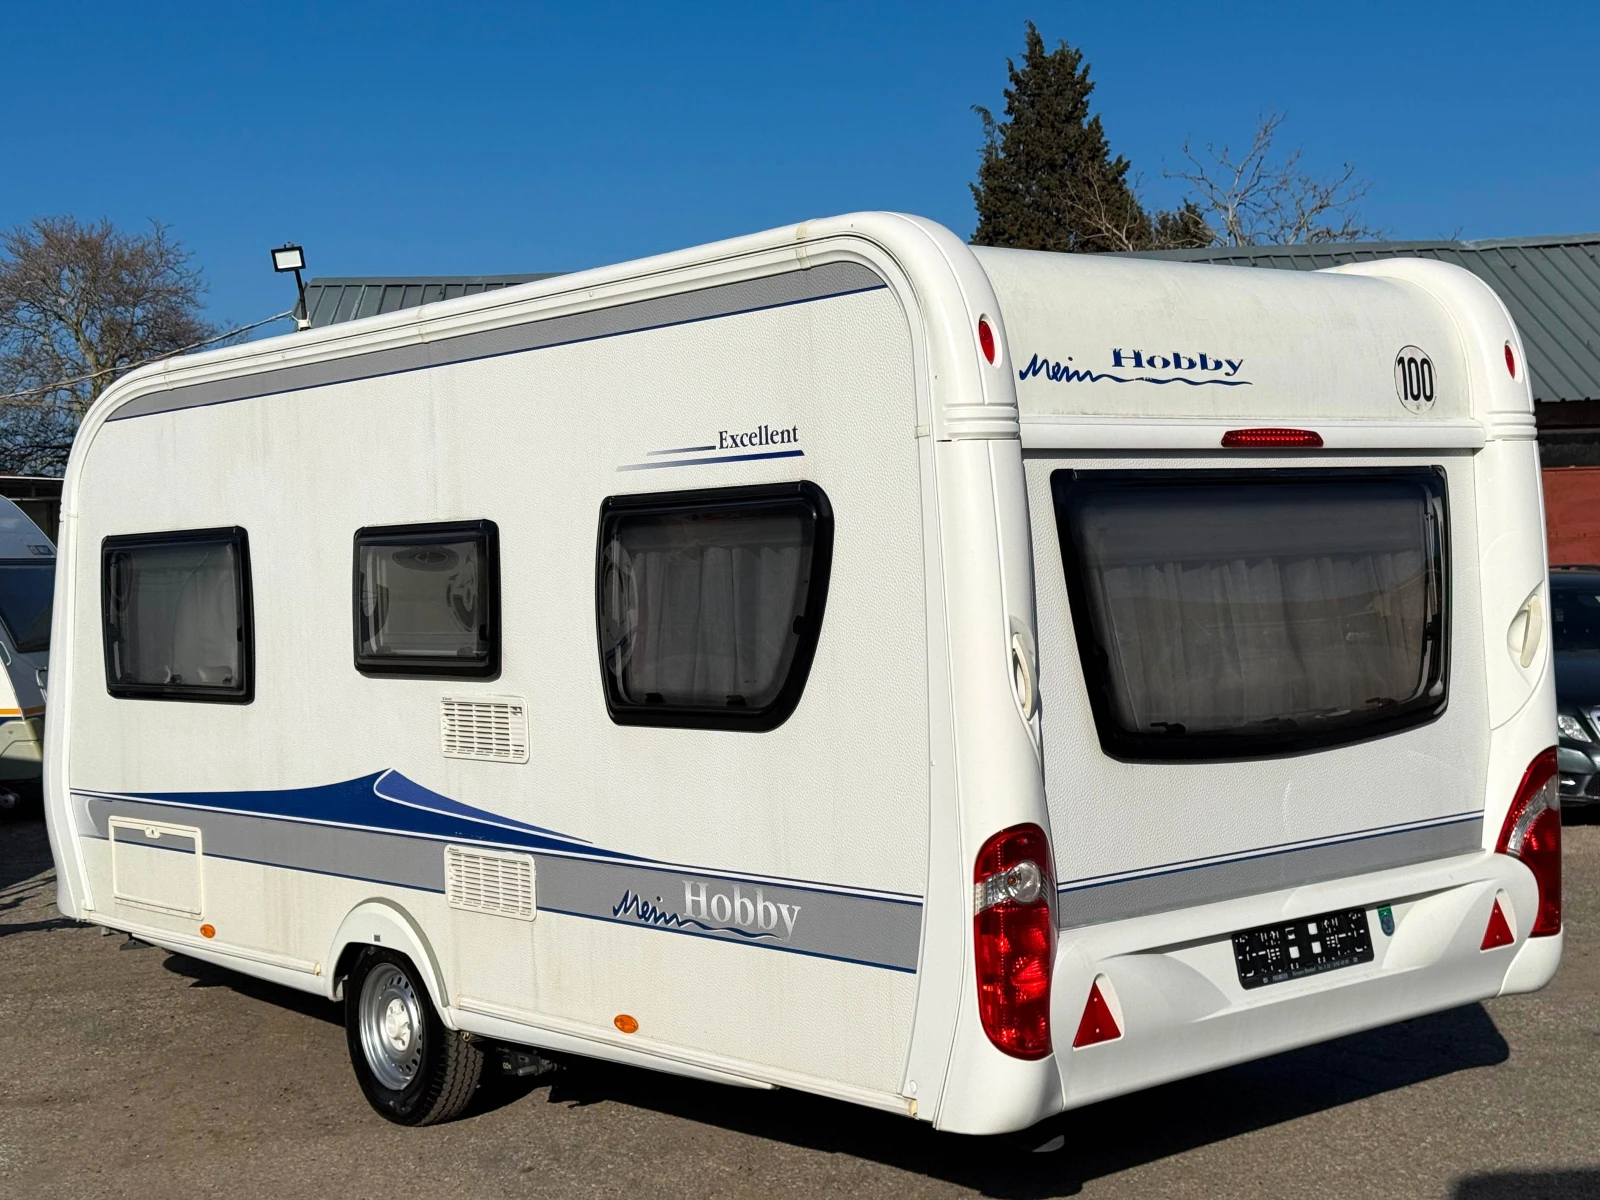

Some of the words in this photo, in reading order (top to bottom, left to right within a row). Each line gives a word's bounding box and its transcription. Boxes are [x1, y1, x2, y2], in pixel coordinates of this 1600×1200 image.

[1019, 353, 1100, 383] Mein
[1111, 348, 1244, 376] Hobby
[1397, 356, 1434, 402] 100
[718, 424, 799, 450] Excellent
[612, 889, 685, 929] Mein
[682, 880, 802, 942] Hobby
